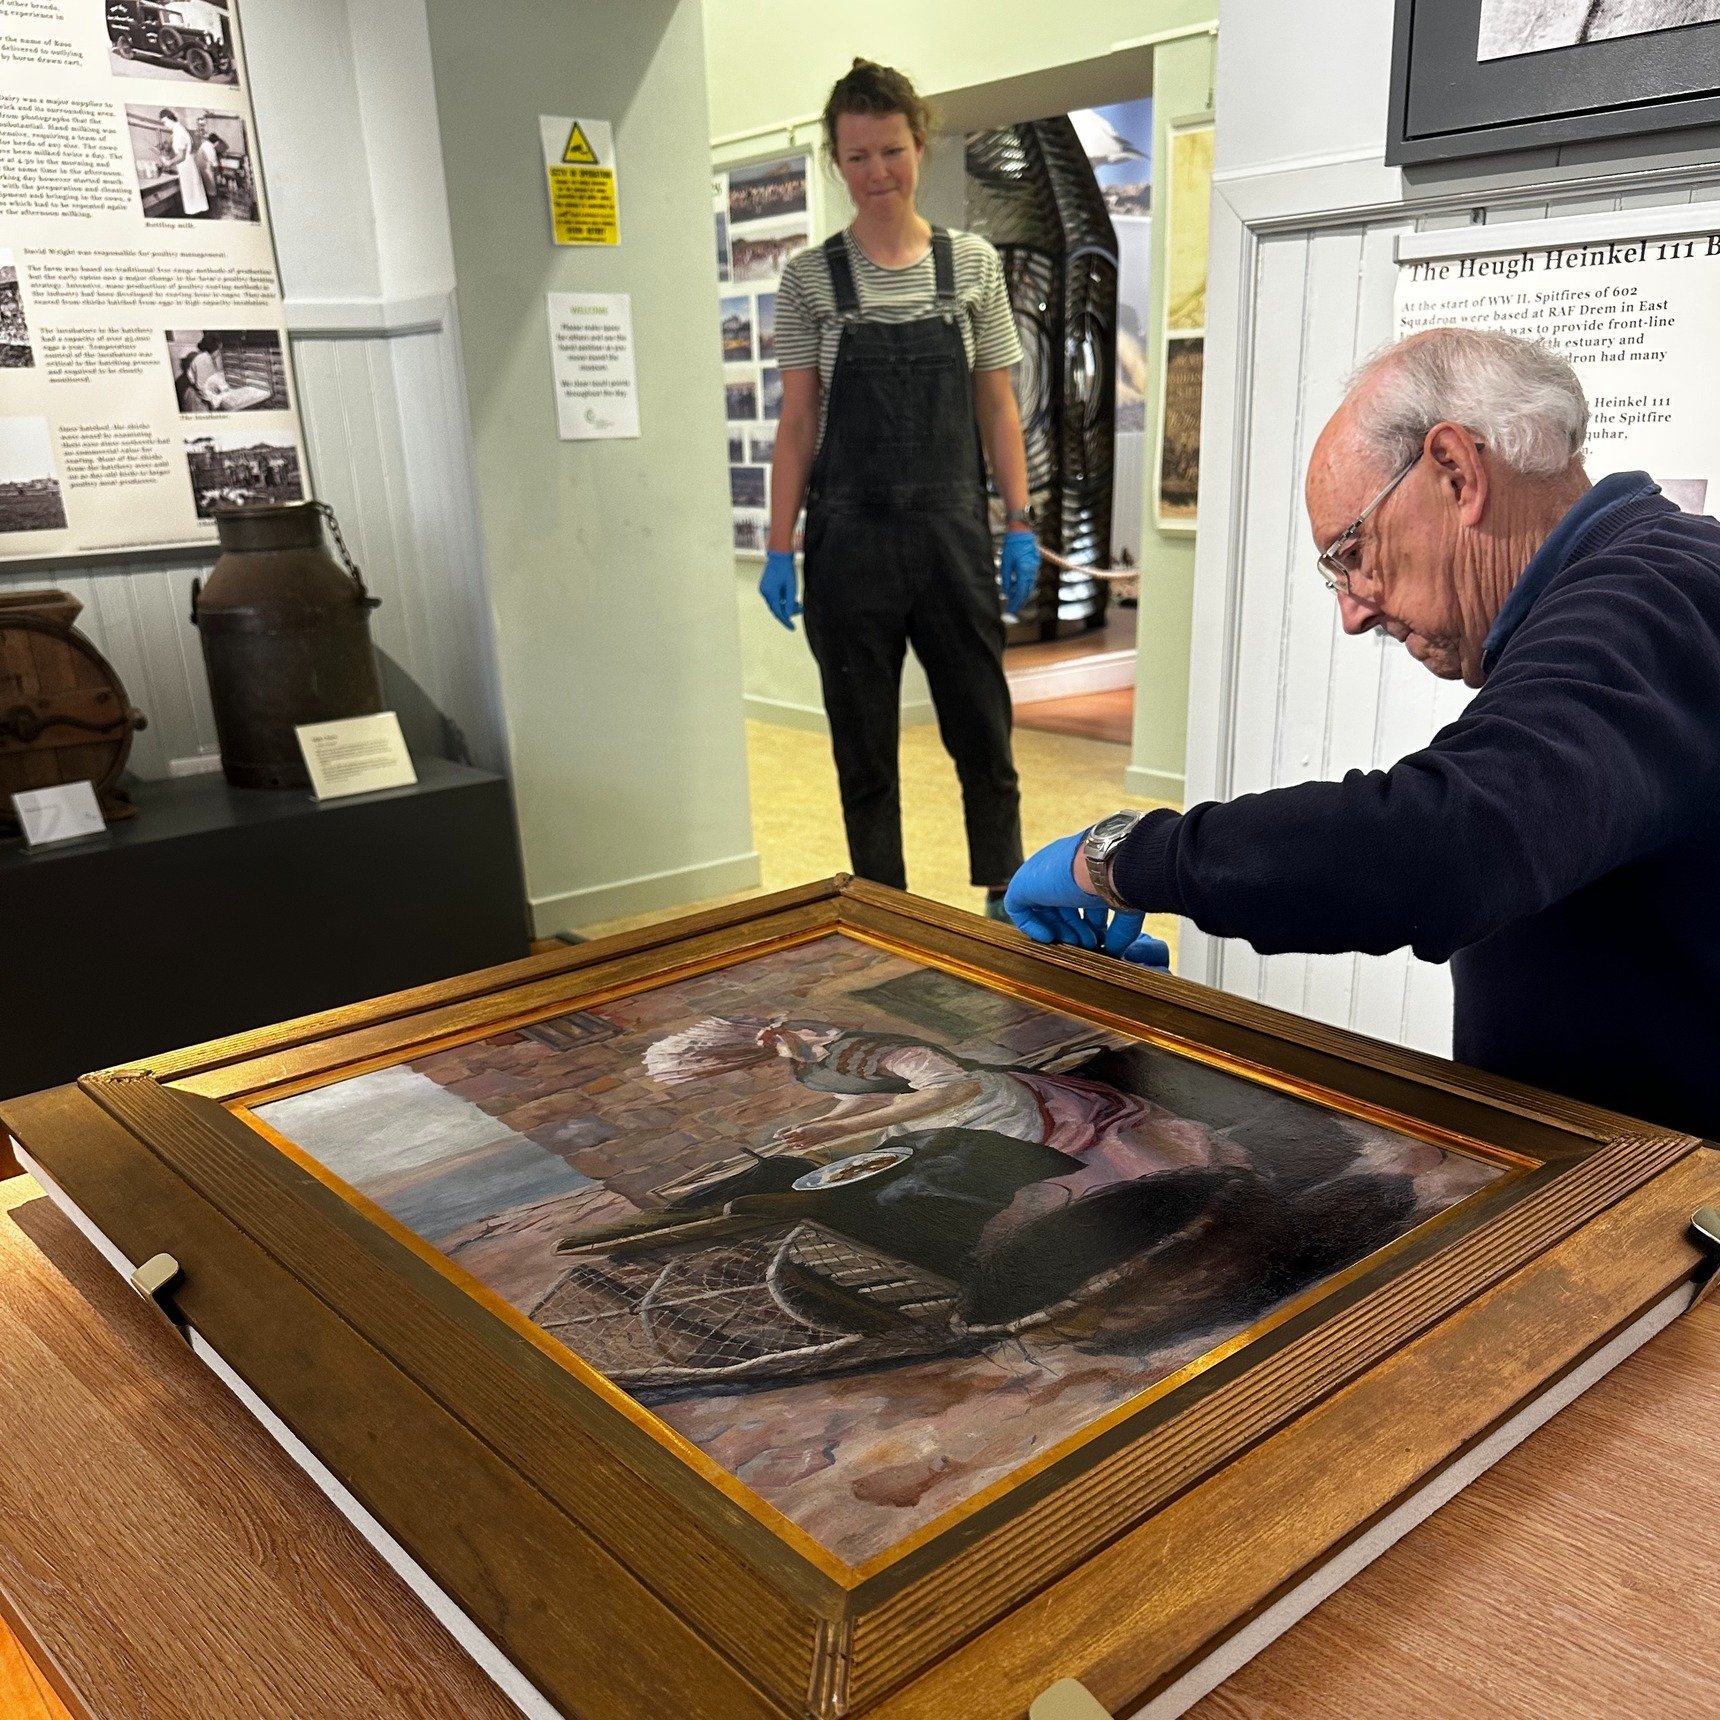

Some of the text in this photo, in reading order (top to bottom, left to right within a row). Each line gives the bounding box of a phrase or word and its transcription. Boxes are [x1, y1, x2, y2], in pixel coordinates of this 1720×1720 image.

[1411, 262, 1450, 282] The
[1458, 252, 1534, 279] Heugh
[1544, 240, 1648, 270] Heinkel
[1656, 241, 1695, 260] 111
[1402, 302, 1415, 312] At
[1419, 300, 1437, 311] the
[1441, 298, 1468, 309] start
[1472, 297, 1485, 308] of
[1488, 294, 1513, 306] WW
[1535, 290, 1591, 305] Spitfires
[1595, 286, 1610, 298] of
[1612, 287, 1638, 297] 602
[1400, 299, 1669, 329] Squadron were based at RAF Drem in East
[1510, 326, 1532, 335] was
[1537, 324, 1549, 333] to
[1552, 319, 1604, 335] provide
[1608, 315, 1675, 330] front-line
[1565, 336, 1615, 348] estuary
[1619, 333, 1645, 345] and
[1600, 350, 1625, 362] had
[1630, 351, 1668, 363] many
[1594, 396, 1648, 408] Heinkel
[1594, 411, 1672, 426] the Spitfire
